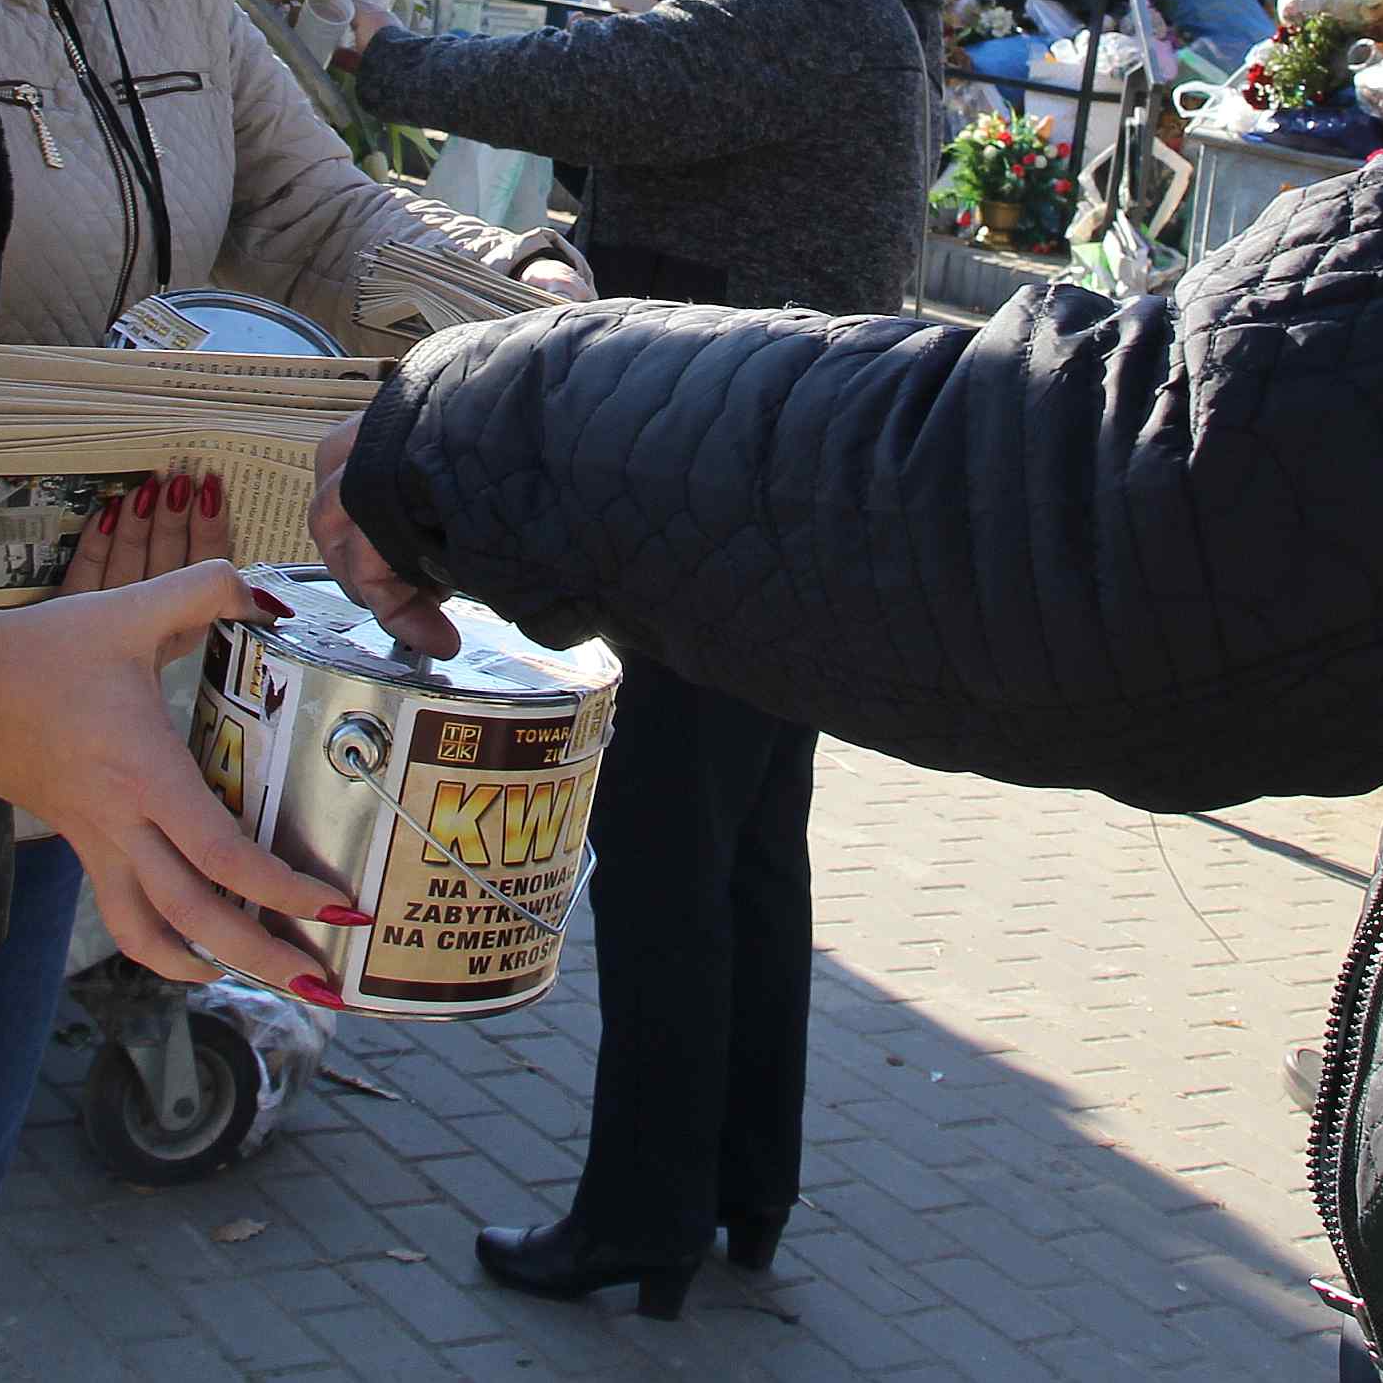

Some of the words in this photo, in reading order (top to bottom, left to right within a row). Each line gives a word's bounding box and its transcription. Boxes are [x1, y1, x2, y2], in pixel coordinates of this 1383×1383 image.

[428, 878, 467, 899] NA
[382, 925, 425, 948] NA
[468, 955, 492, 975] W
